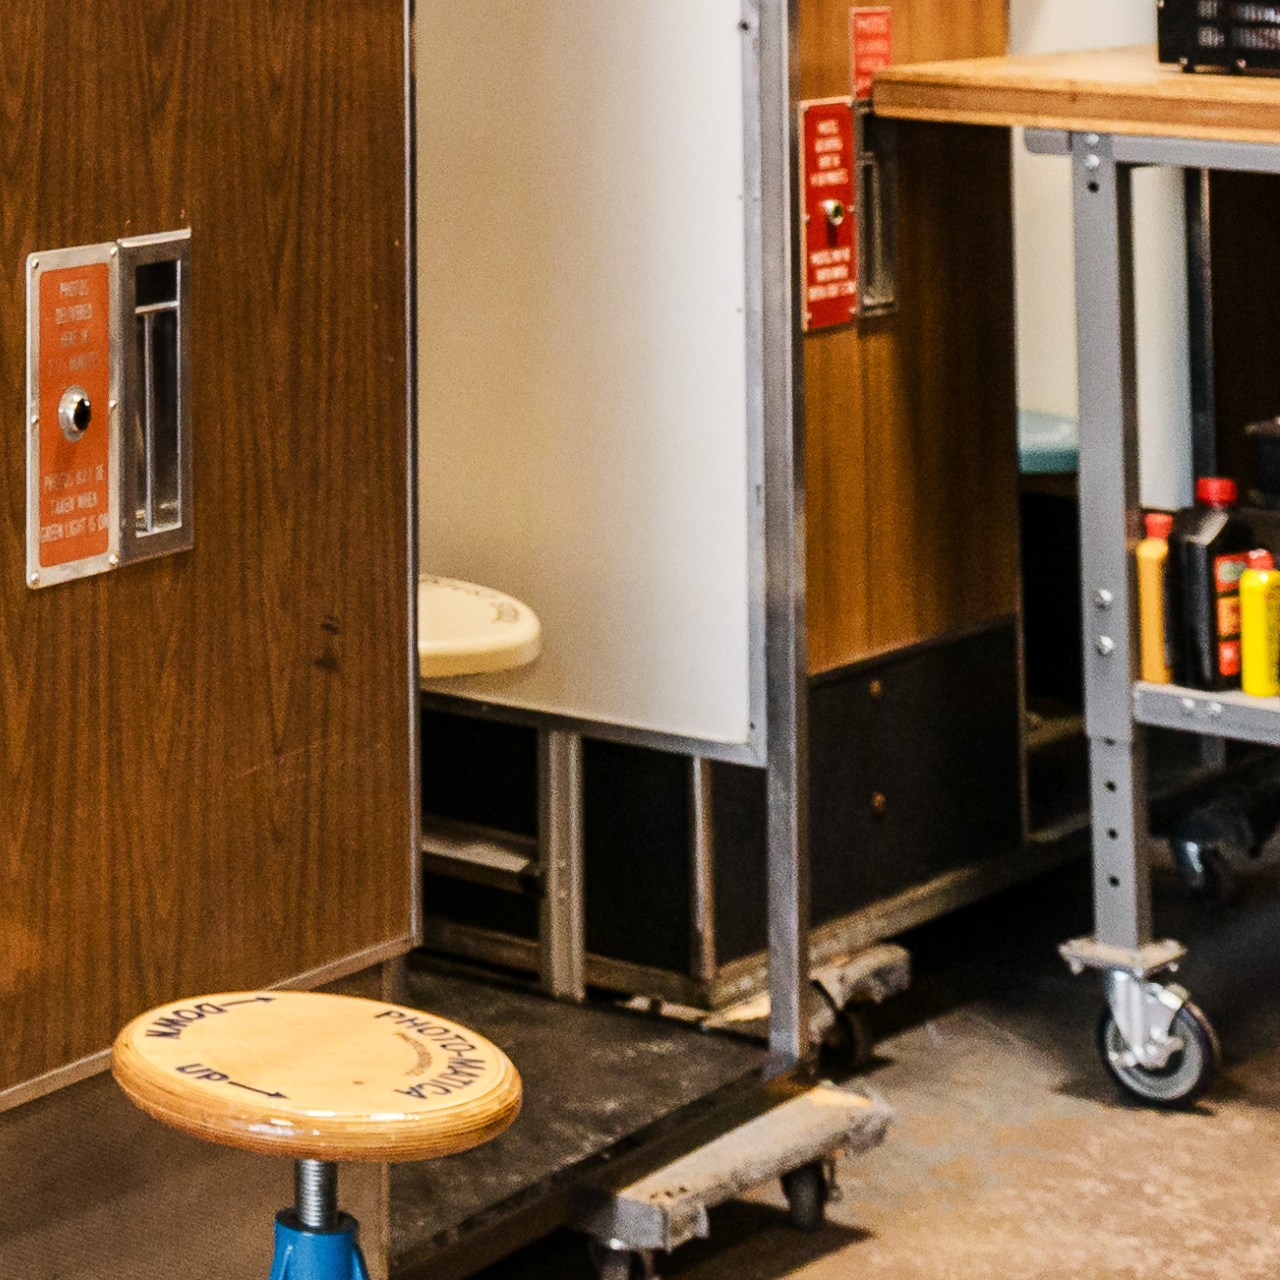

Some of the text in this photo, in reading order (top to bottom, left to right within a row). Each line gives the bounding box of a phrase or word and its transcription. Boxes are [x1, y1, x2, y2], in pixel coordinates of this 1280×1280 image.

[145, 1002, 225, 1040] DOWN
[175, 1062, 229, 1083] UP
[374, 1009, 487, 1101] PHOTO-MATICA
